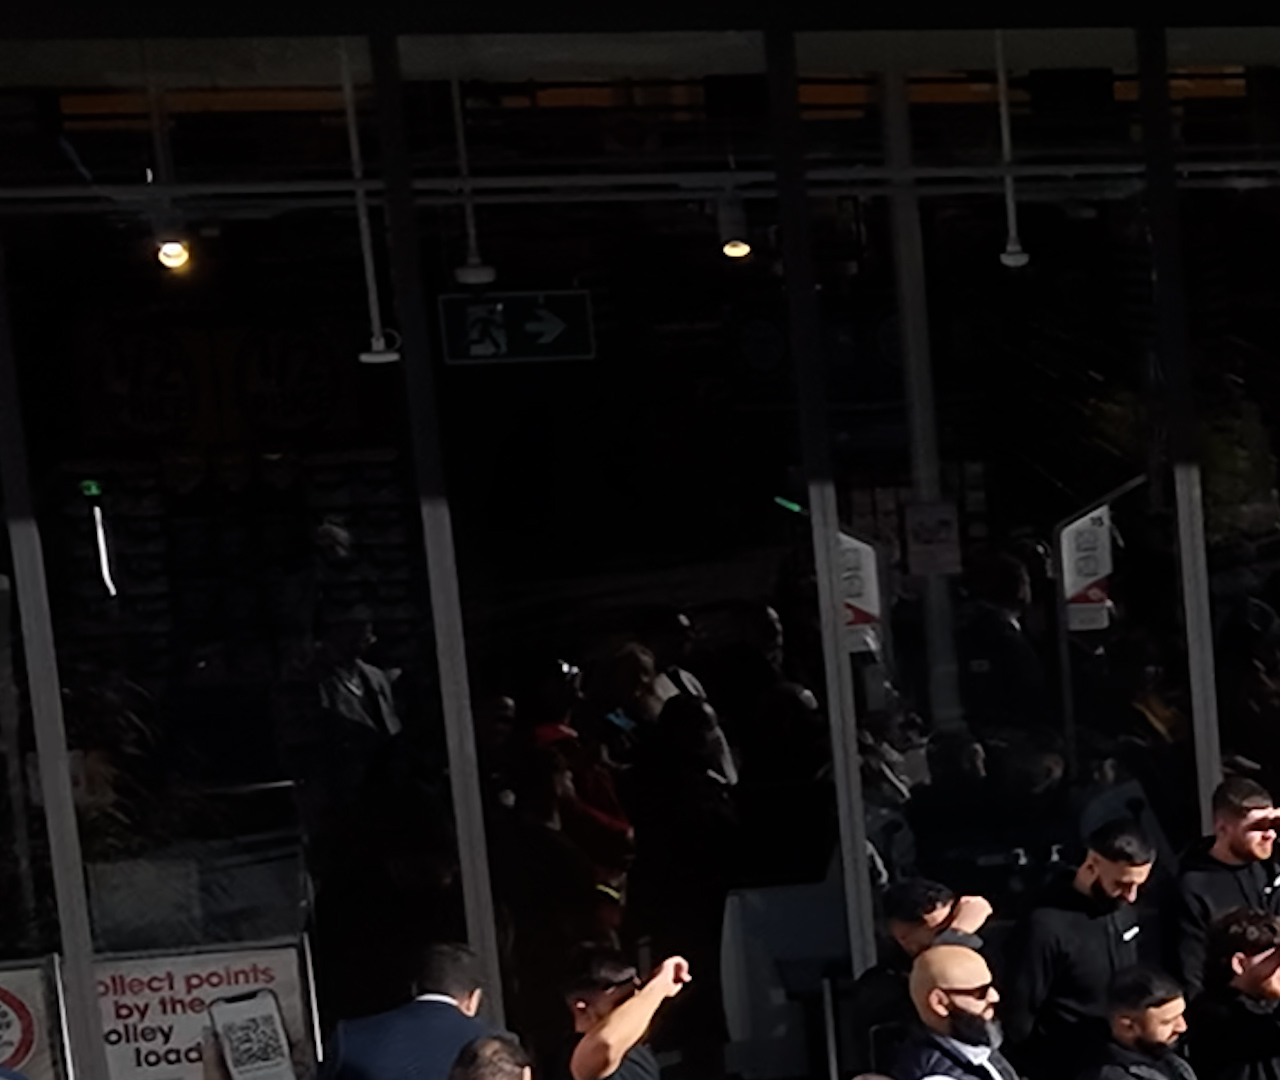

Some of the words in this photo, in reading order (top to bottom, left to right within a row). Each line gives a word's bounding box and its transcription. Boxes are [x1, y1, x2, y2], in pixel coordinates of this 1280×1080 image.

[97, 971, 175, 997] ollect
[185, 963, 276, 994] points
[115, 1001, 150, 1022] by
[159, 996, 205, 1016] the
[104, 1023, 174, 1046] olley
[136, 1042, 203, 1068] load
